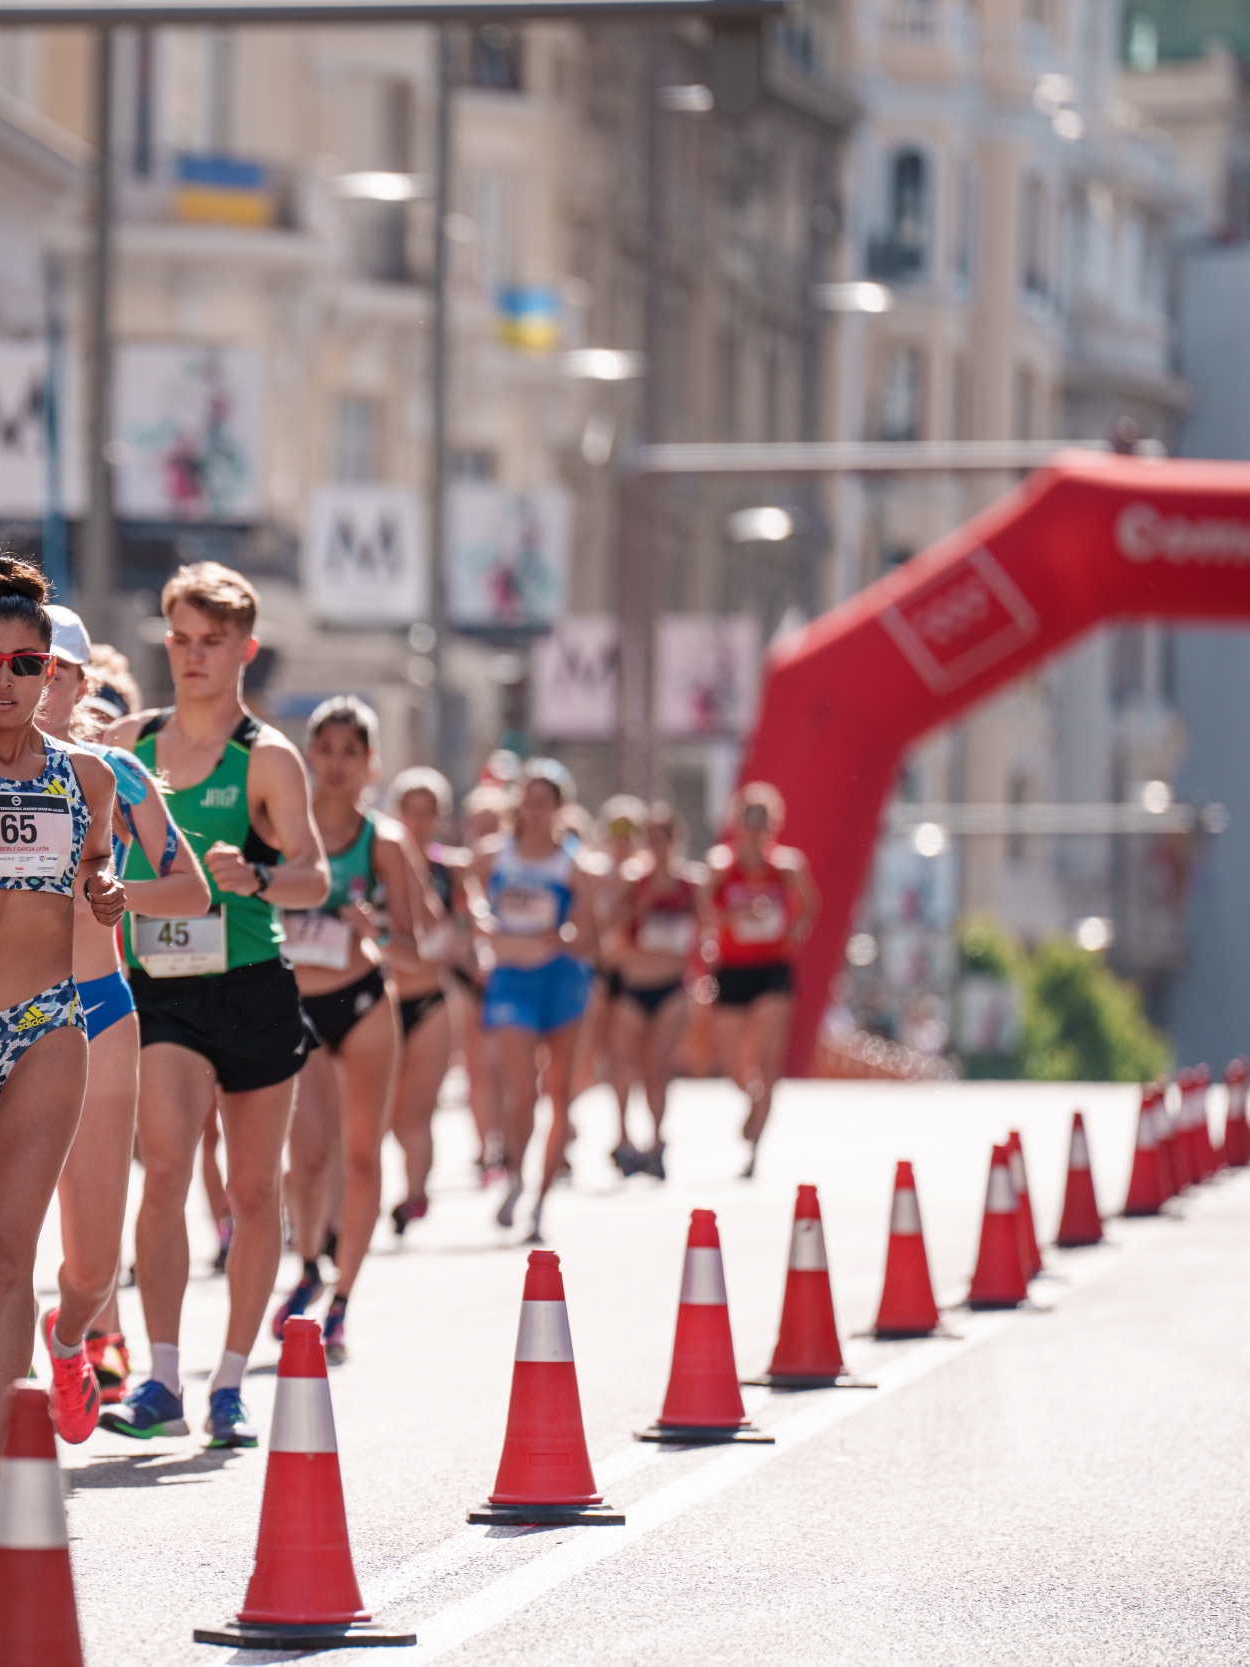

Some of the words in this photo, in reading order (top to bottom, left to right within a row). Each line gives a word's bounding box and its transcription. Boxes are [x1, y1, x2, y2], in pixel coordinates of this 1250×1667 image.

[0, 814, 38, 844] 65
[157, 921, 190, 947] 45
[15, 1015, 52, 1033] adidas
